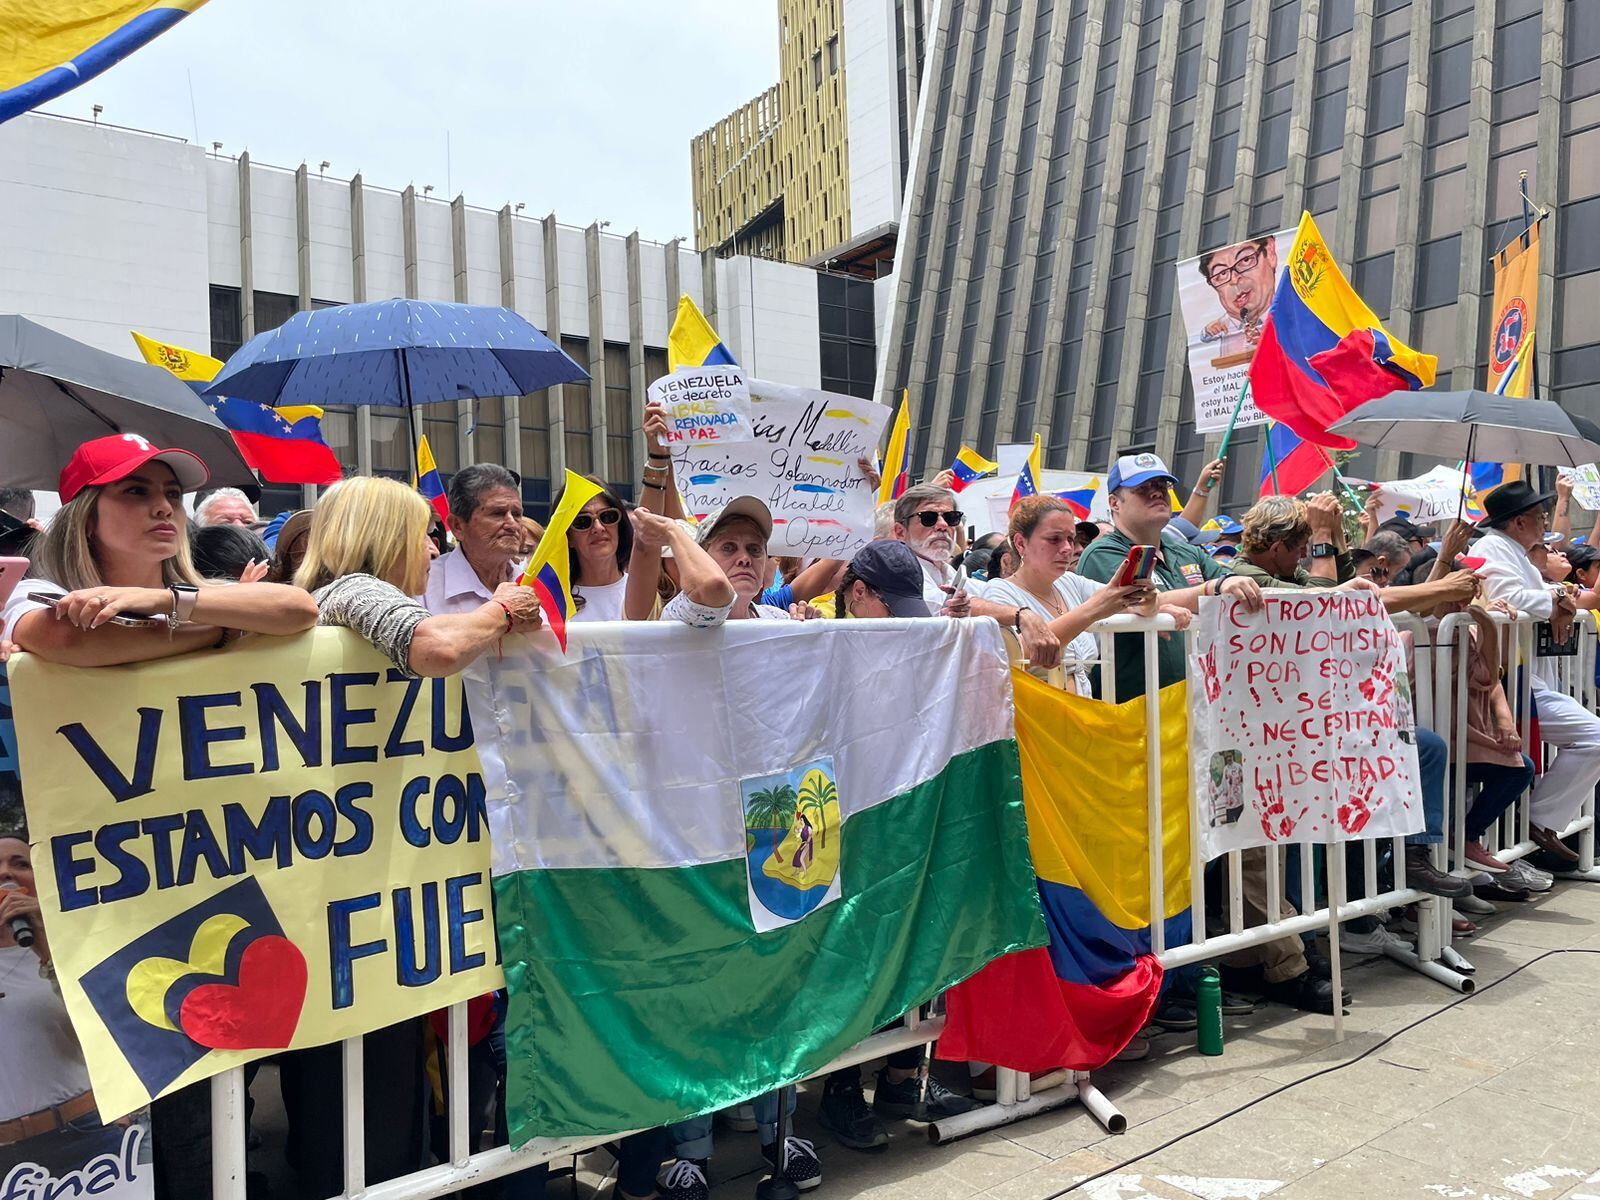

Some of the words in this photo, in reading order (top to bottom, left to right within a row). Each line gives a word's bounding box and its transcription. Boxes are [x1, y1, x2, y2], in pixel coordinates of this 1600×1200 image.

[658, 375, 743, 394] VENEZUELA
[1202, 375, 1226, 386] Estoy
[1227, 369, 1250, 381] hacie
[683, 388, 732, 402] decreto
[1213, 386, 1221, 395] el
[1222, 382, 1241, 393] MAL
[669, 400, 720, 419] IBRE
[1201, 397, 1222, 408] estoy
[675, 413, 739, 430] RENOVADA
[1204, 409, 1212, 419] el
[1213, 406, 1232, 417] MAL
[666, 431, 683, 442] EN
[689, 427, 720, 440] PAZ
[671, 445, 758, 478] Gracias
[1414, 491, 1457, 520] Libre
[1297, 690, 1333, 714] SE
[56, 668, 475, 803] VENEZU
[52, 781, 375, 912] ESTAMOS
[327, 867, 502, 1011] FUE
[1, 1128, 140, 1200] final
